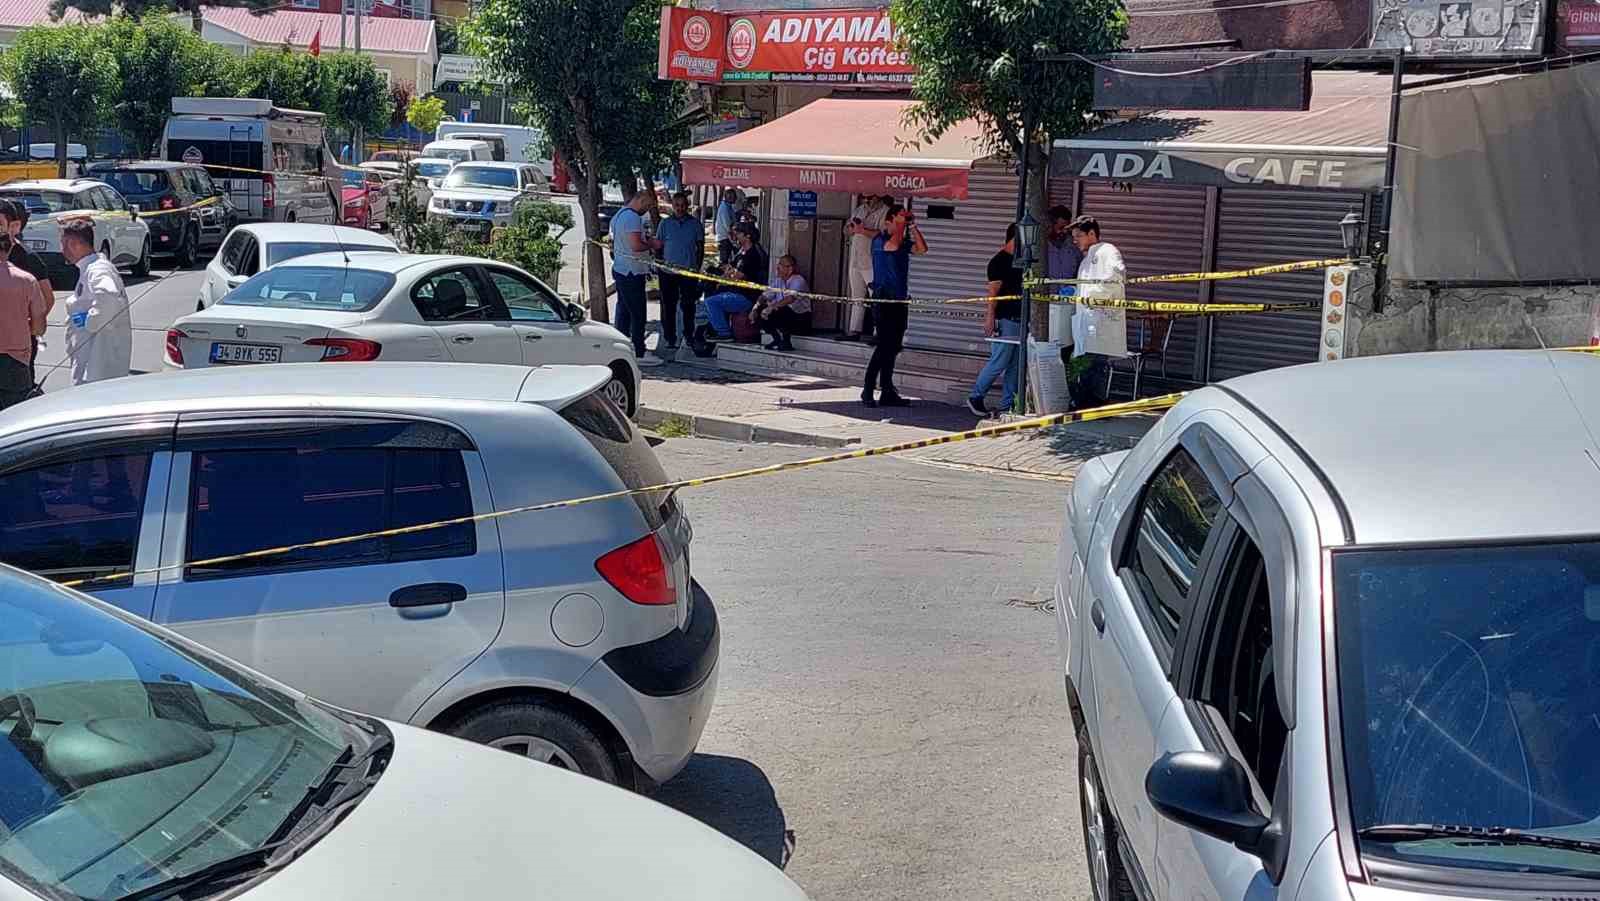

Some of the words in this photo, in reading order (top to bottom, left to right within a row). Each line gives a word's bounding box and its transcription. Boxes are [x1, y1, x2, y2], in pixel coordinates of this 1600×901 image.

[804, 47, 836, 69] Çiğ
[1080, 153, 1173, 179] ADA
[1224, 157, 1346, 187] CAFE
[799, 170, 836, 186] MANTI
[218, 345, 230, 359] 34
[234, 346, 254, 361] BYK
[258, 348, 278, 362] 555
